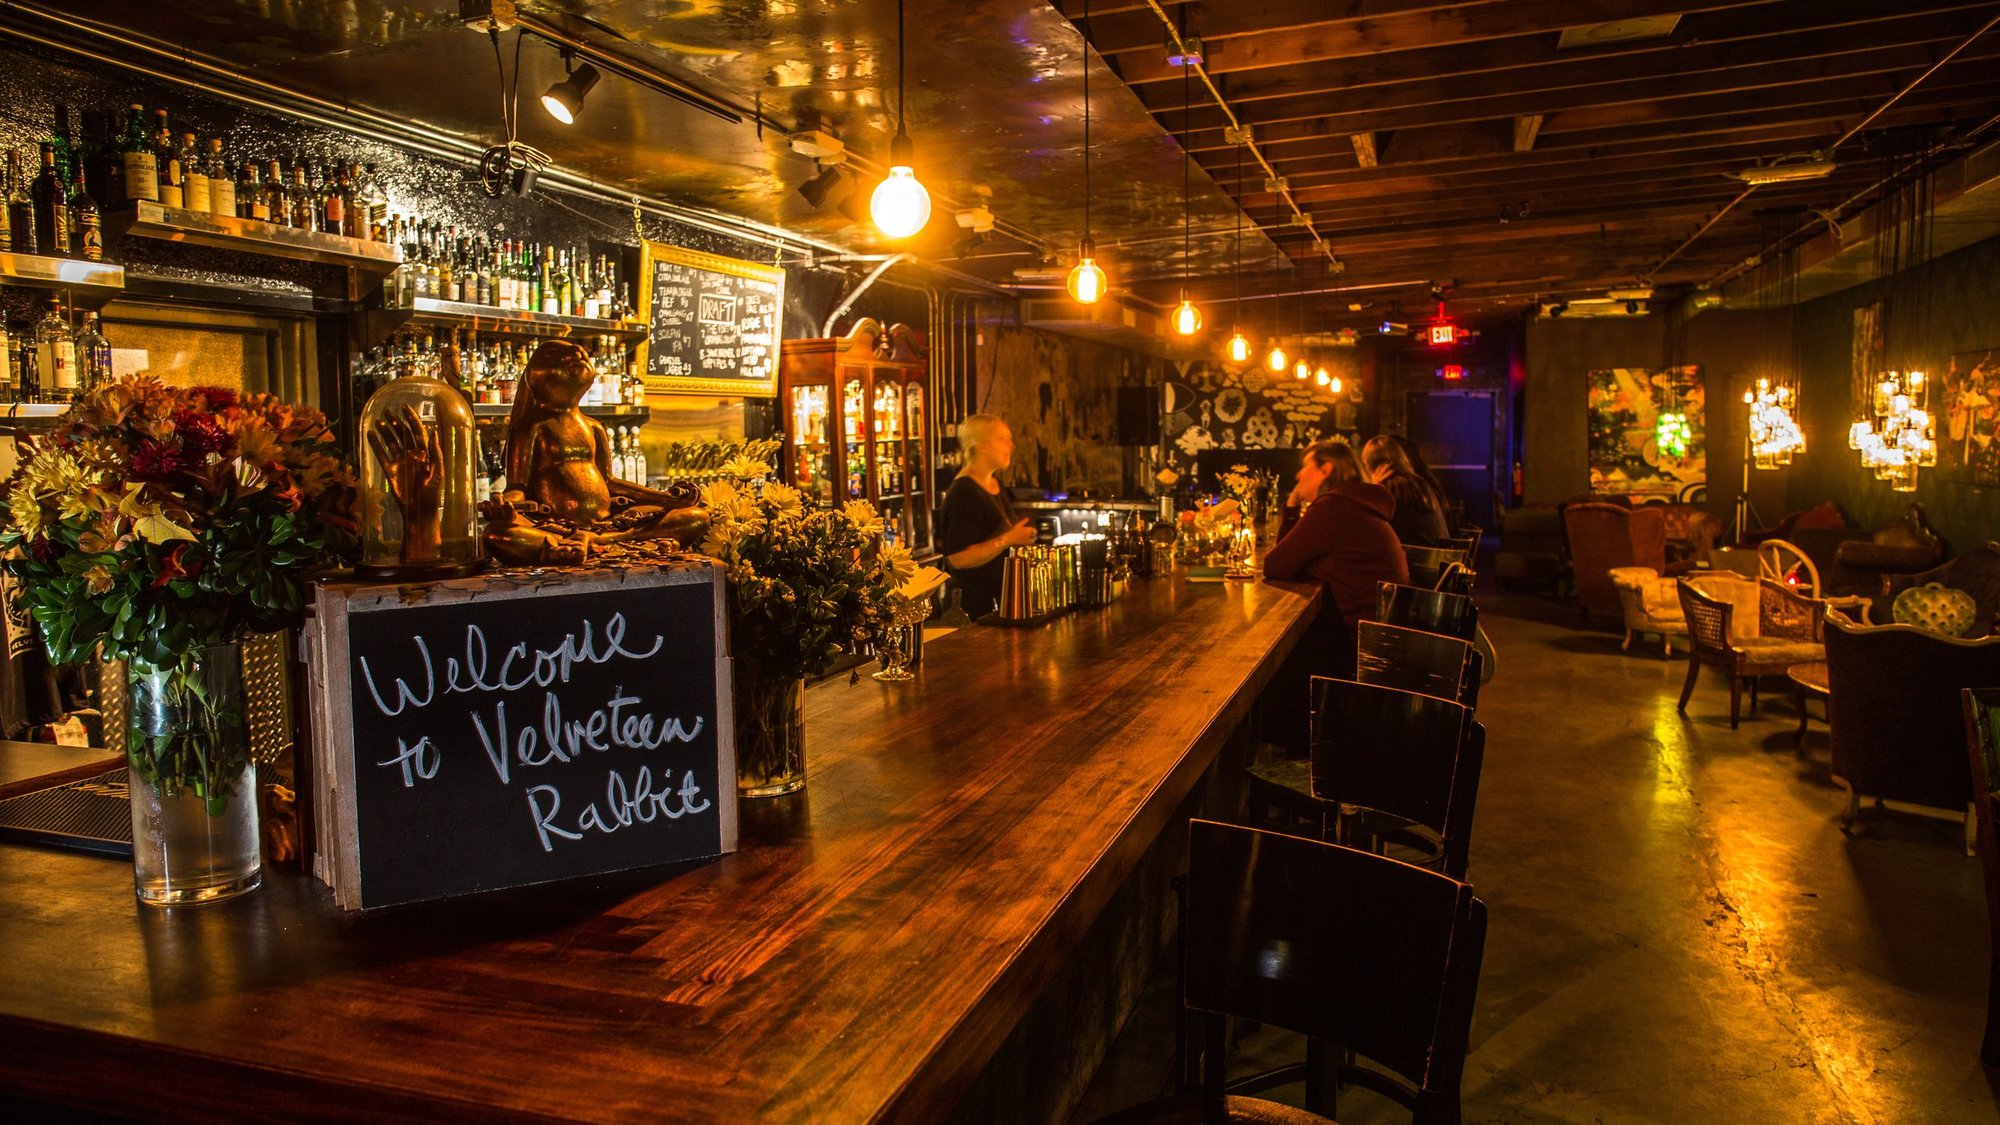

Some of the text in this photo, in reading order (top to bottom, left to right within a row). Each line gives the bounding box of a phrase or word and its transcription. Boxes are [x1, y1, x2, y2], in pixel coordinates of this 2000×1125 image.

[703, 298, 736, 321] DRAFT
[1433, 327, 1453, 342] EXIT
[360, 611, 664, 717] Welcome
[377, 685, 704, 788] to Velveteen
[526, 766, 711, 852] Rabbit
